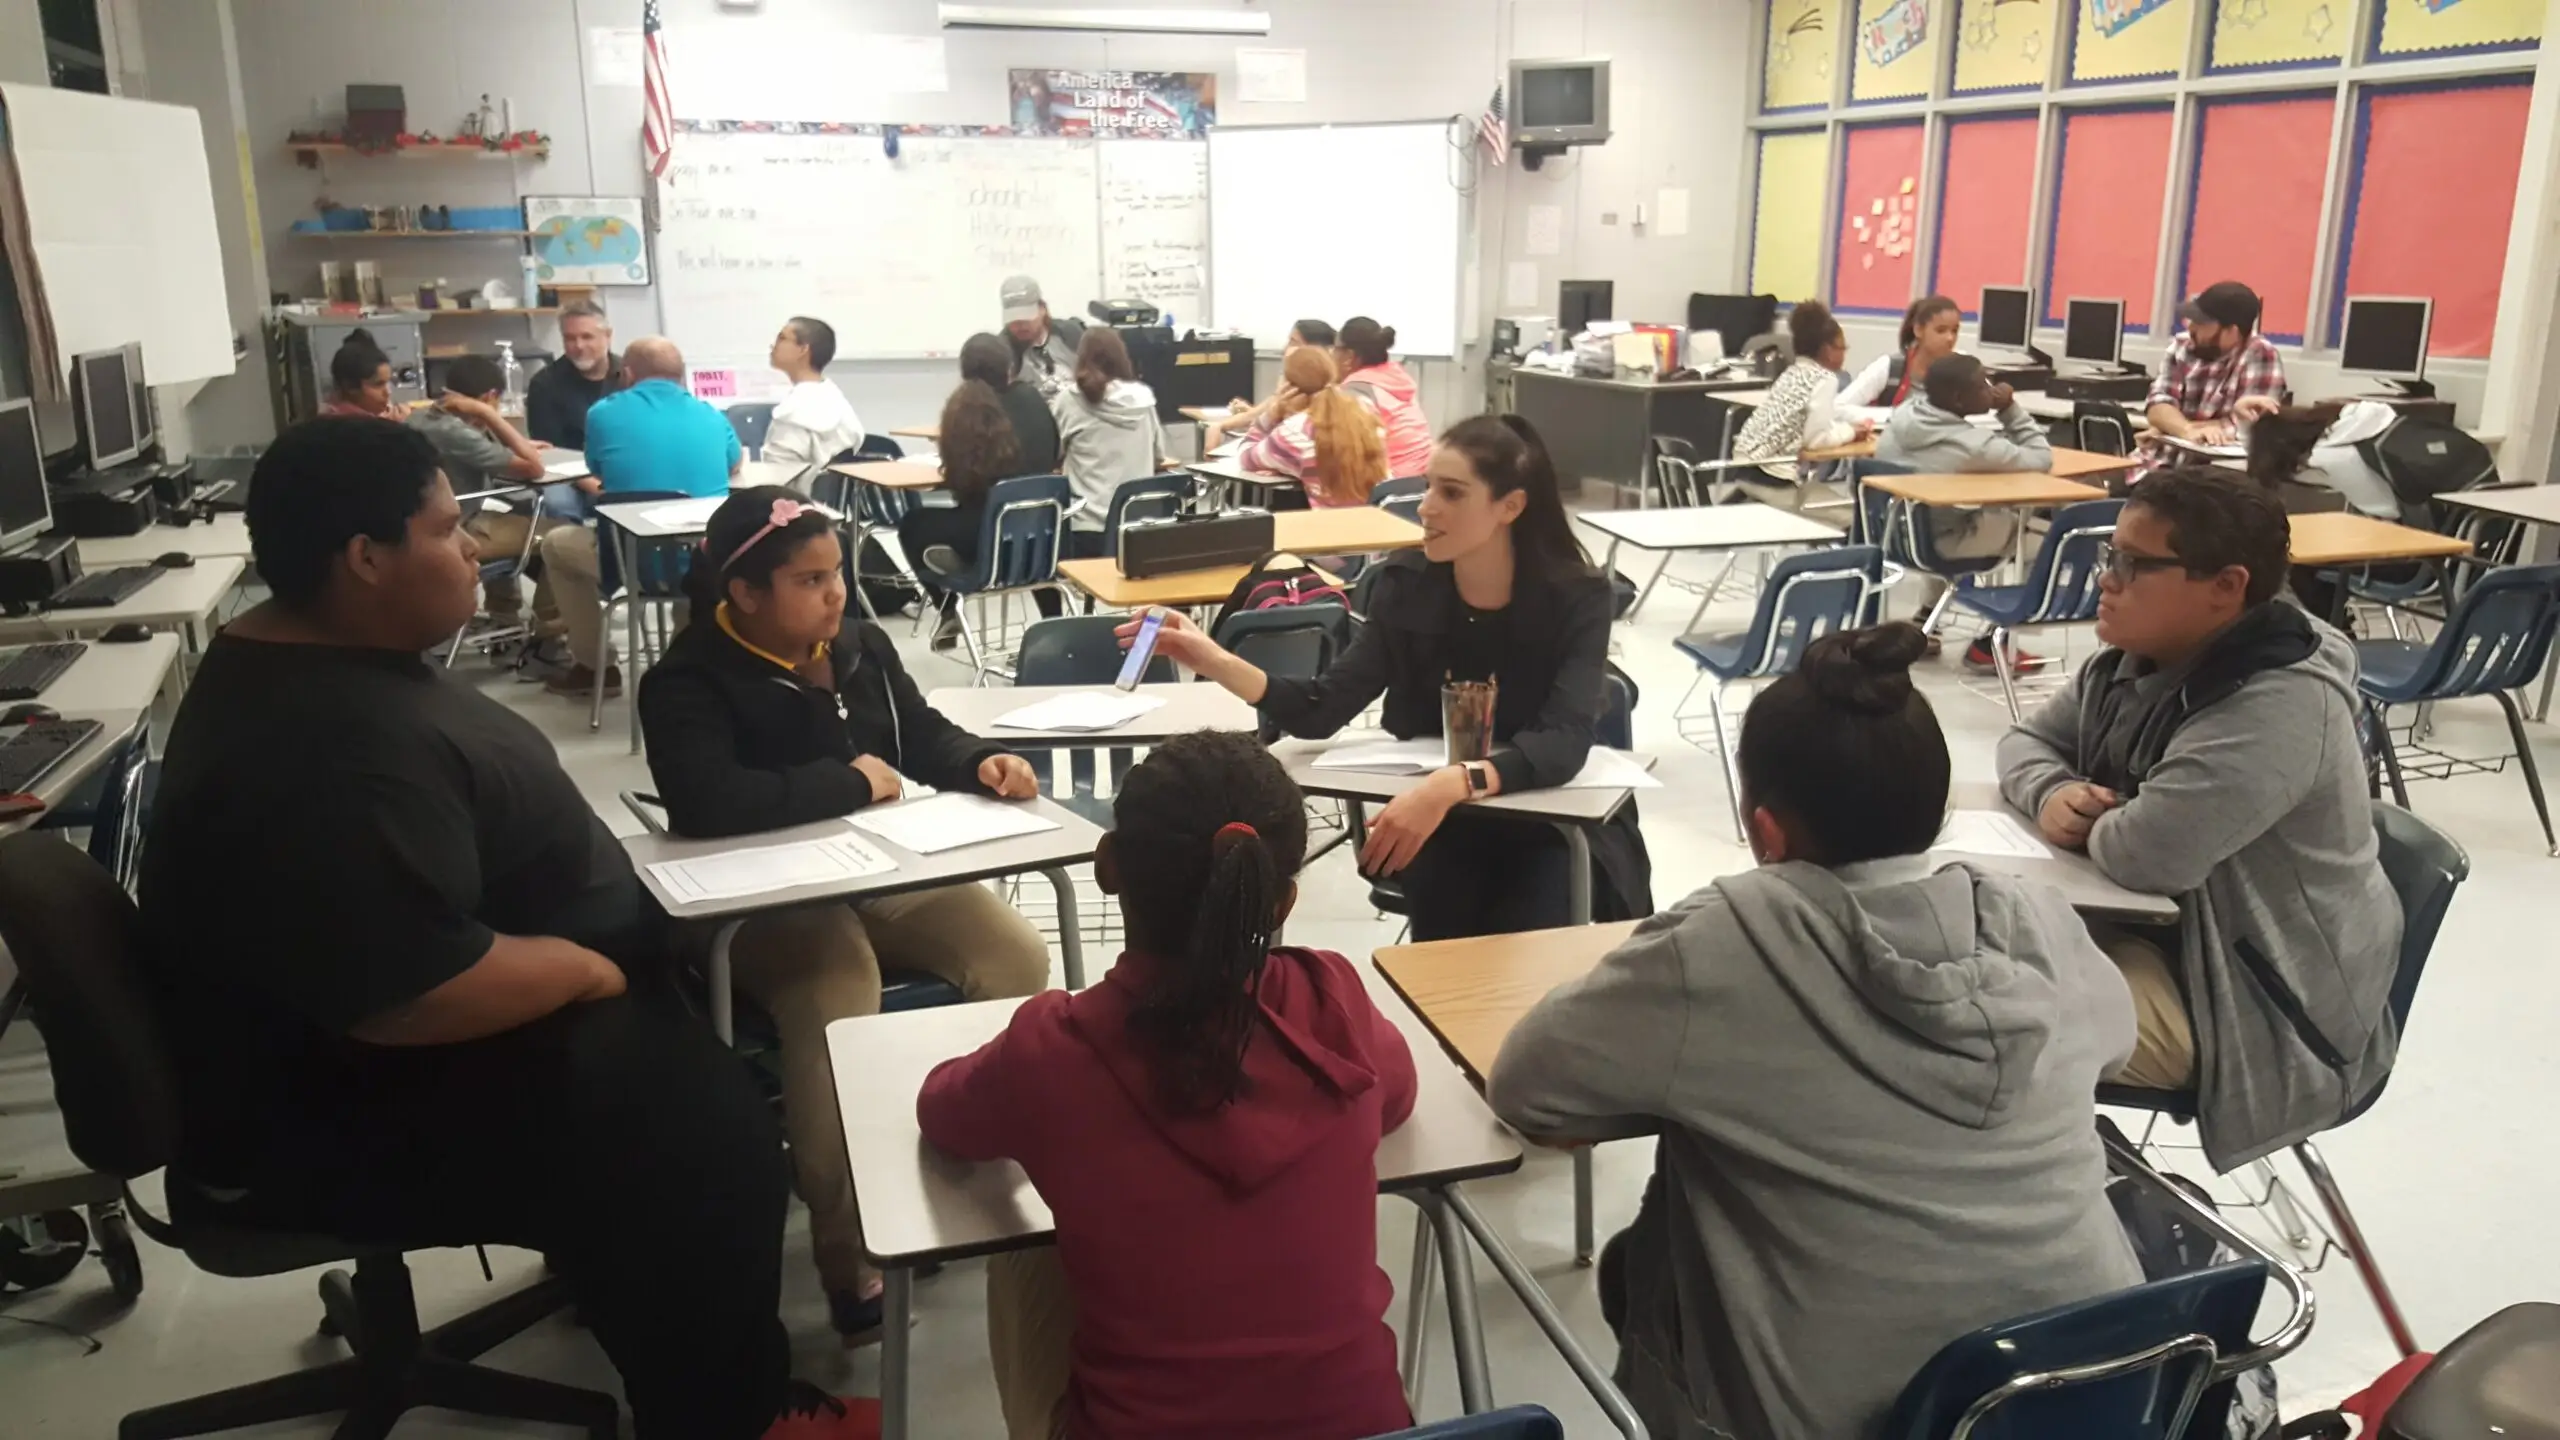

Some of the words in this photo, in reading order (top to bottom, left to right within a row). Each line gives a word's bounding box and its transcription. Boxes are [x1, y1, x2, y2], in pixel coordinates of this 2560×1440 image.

[1073, 91, 1121, 108] Land
[1126, 91, 1146, 108] of
[1089, 111, 1120, 127] the
[1125, 111, 1169, 128] Free
